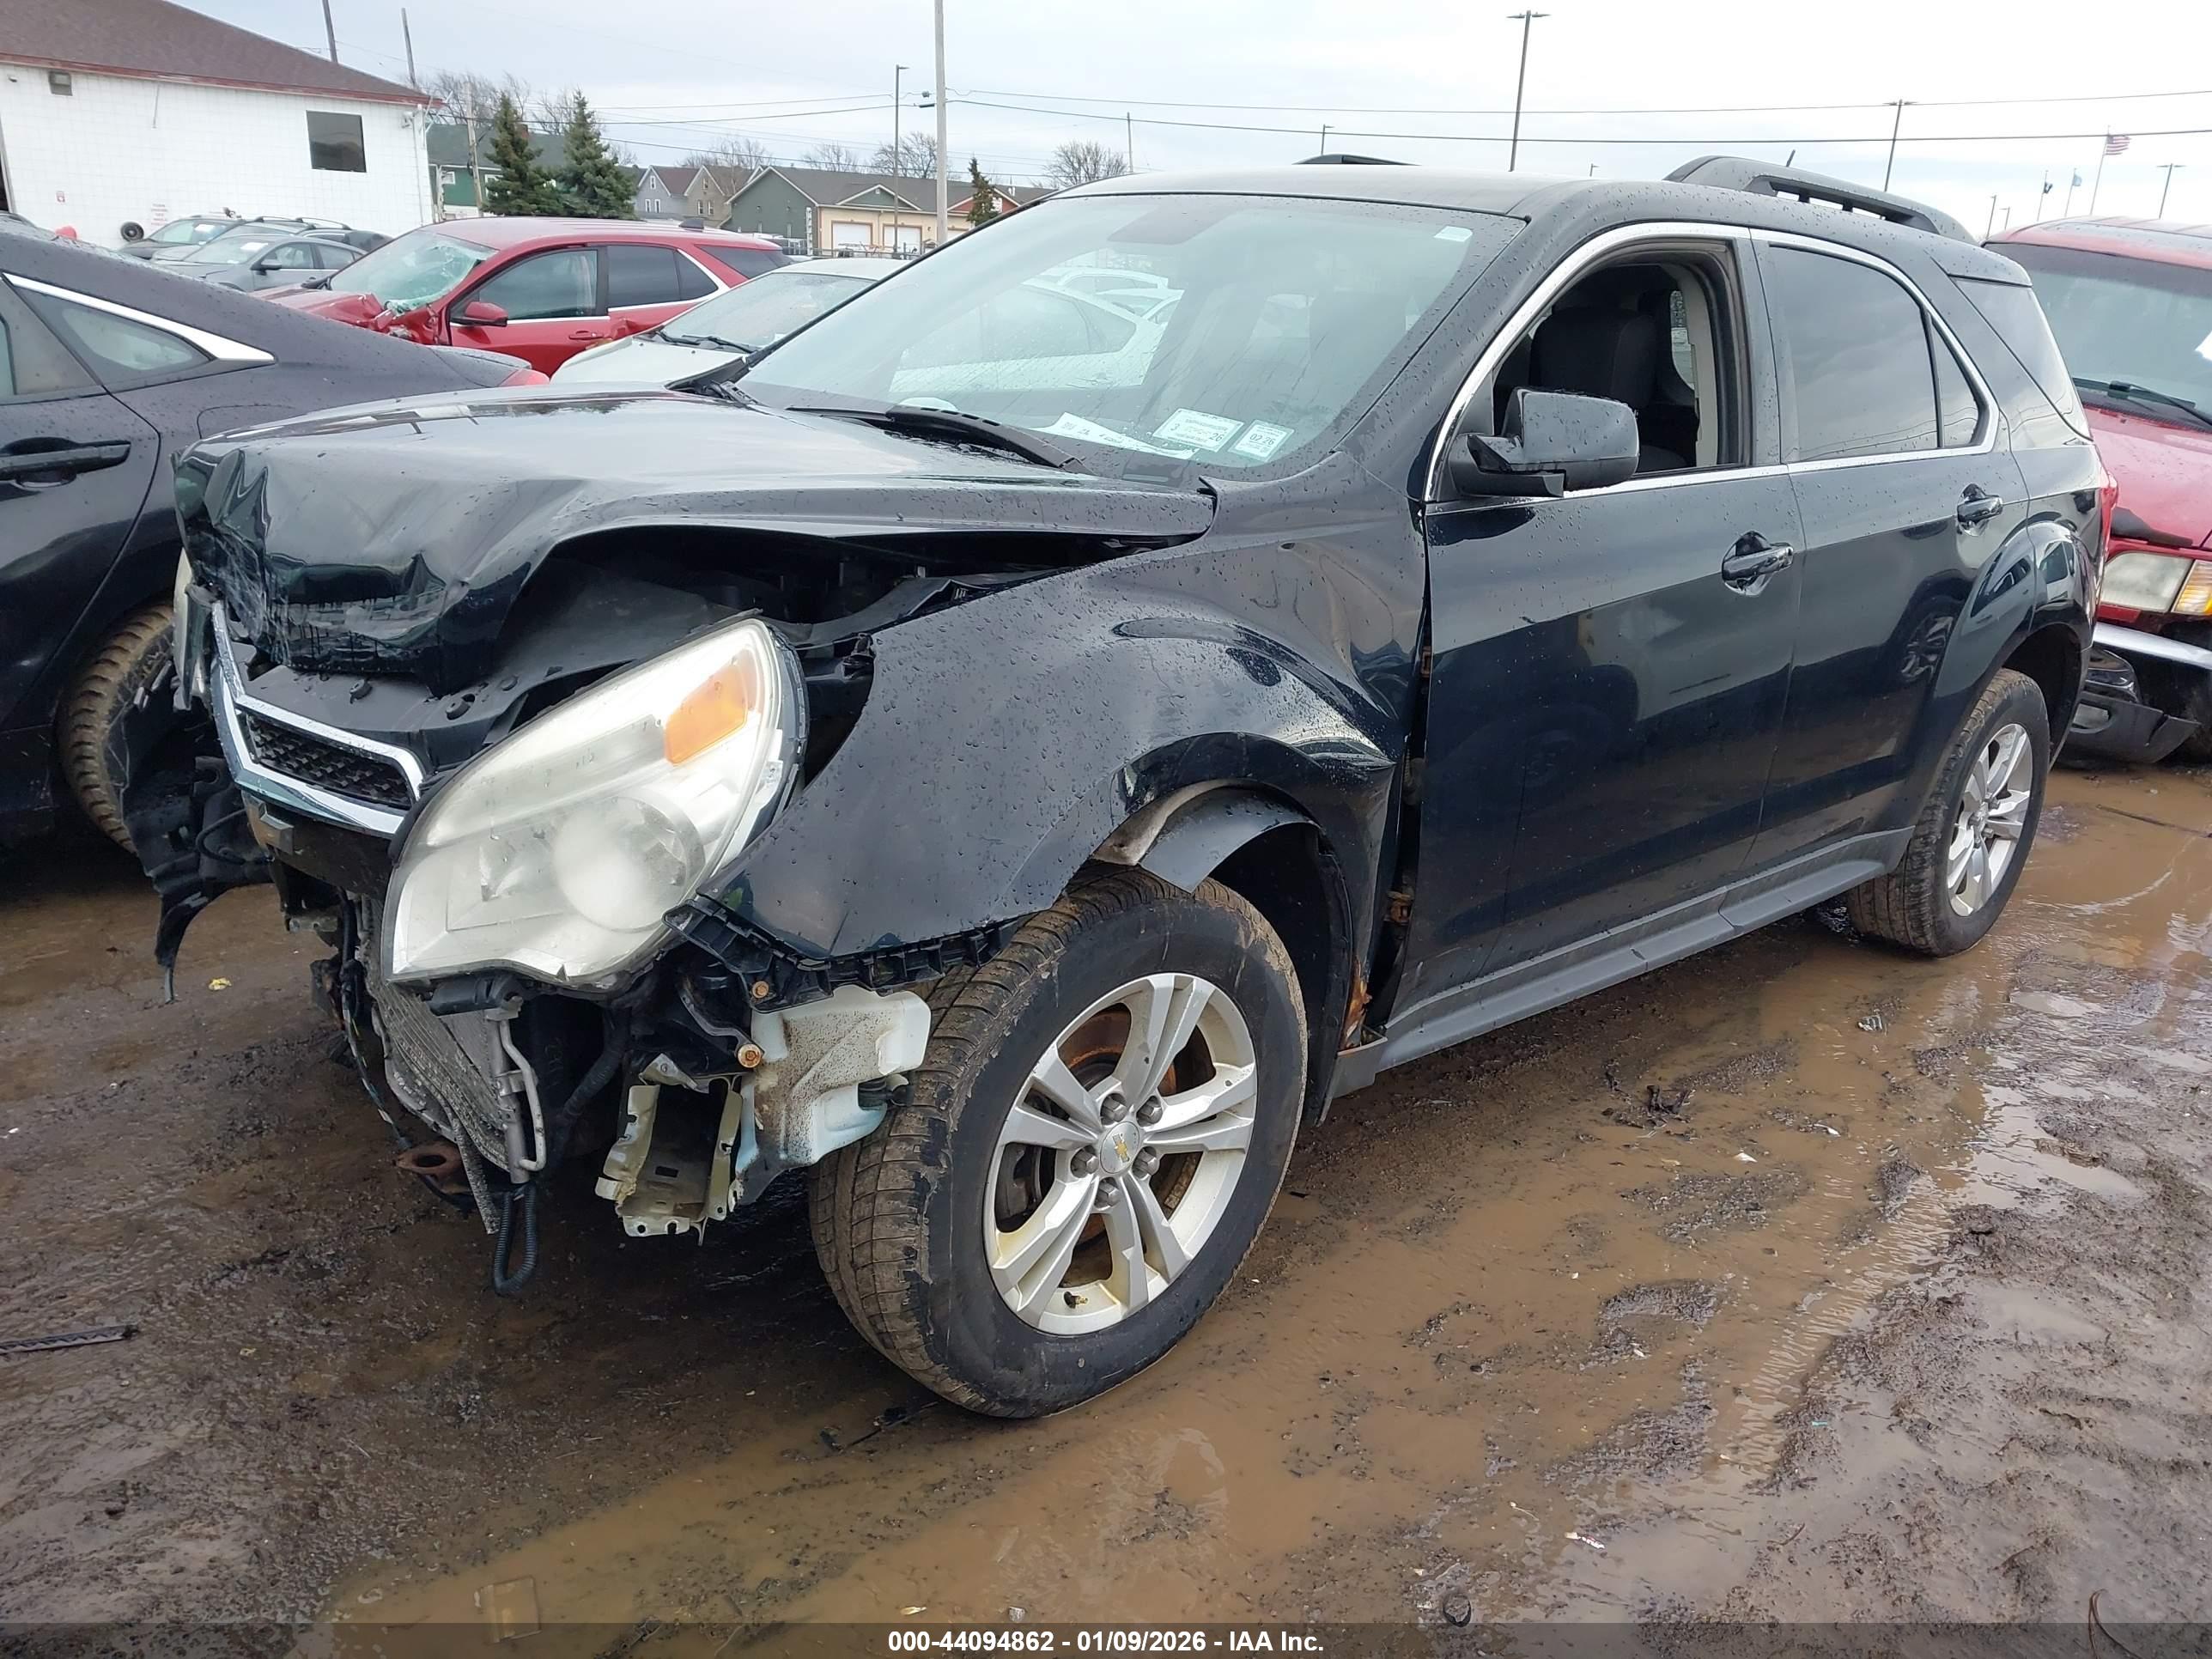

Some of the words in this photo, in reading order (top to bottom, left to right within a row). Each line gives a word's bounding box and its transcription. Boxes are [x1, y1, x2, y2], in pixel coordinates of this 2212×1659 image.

[1209, 432, 1224, 442] 26
[1249, 433, 1263, 442] 02
[1262, 436, 1276, 447] 26
